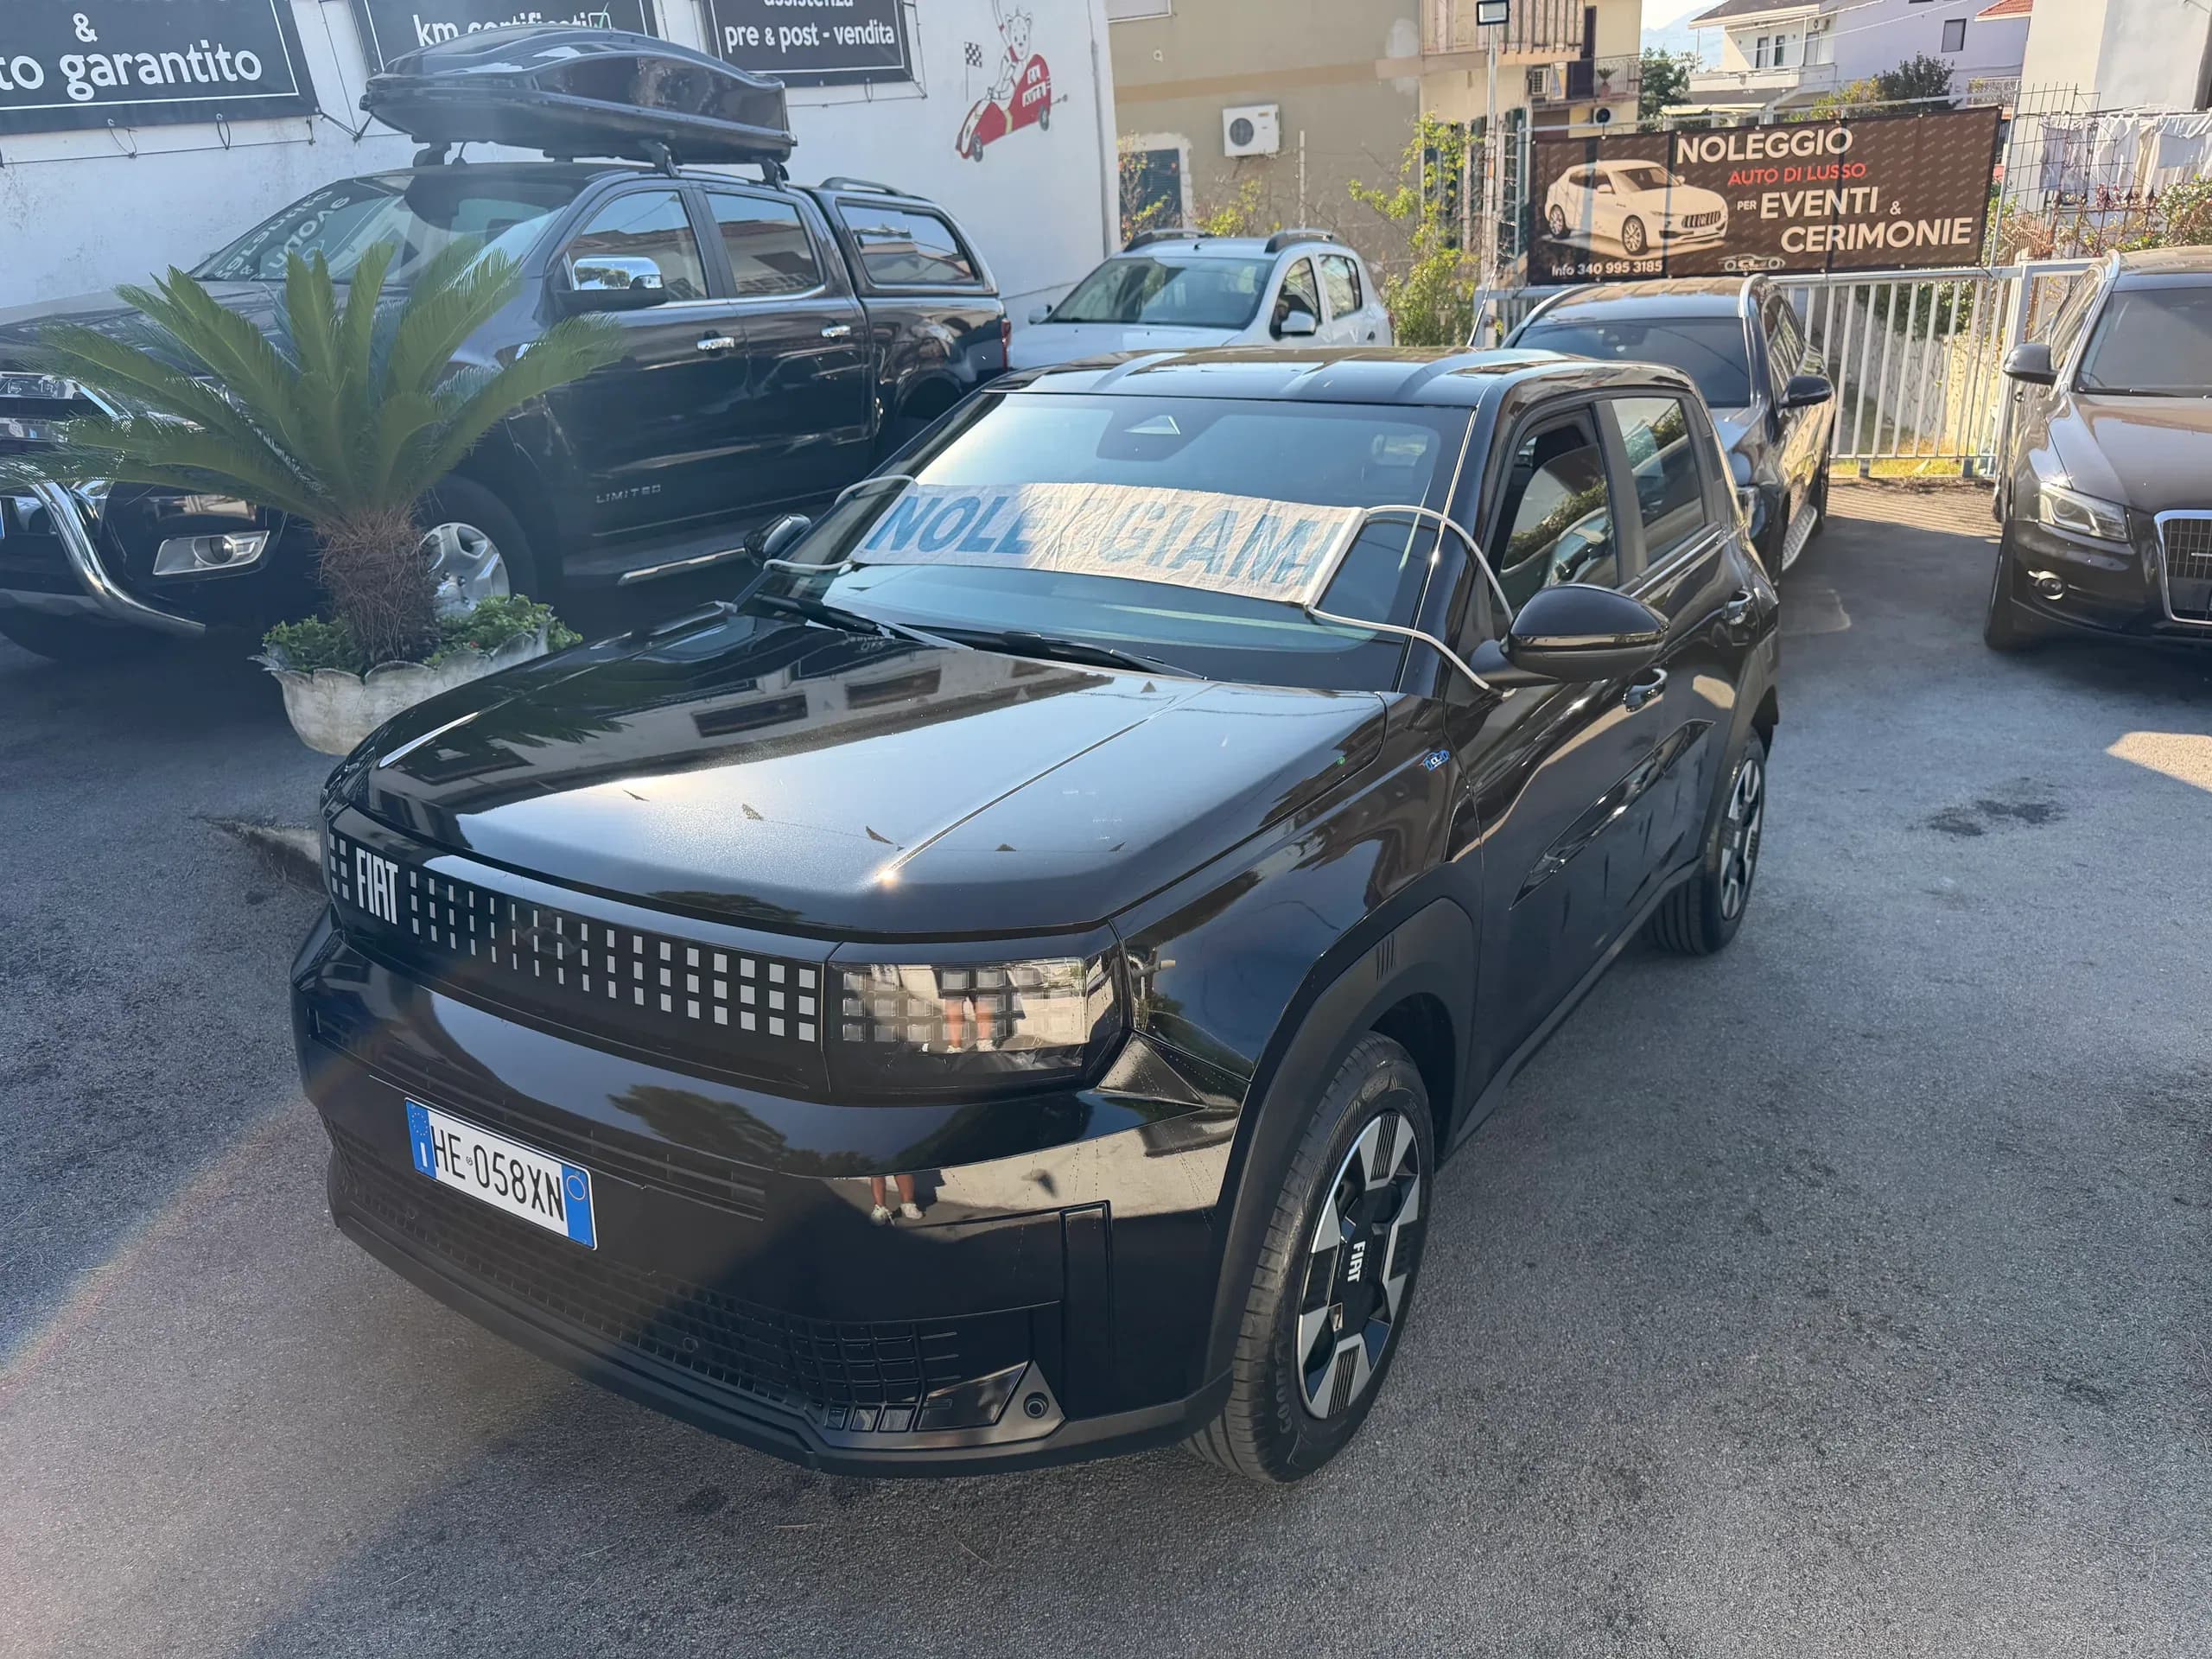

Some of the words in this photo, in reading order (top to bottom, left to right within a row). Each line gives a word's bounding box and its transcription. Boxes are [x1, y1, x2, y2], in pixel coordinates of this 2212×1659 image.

[73, 13, 99, 42] &
[413, 14, 459, 47] km
[724, 26, 760, 54] pre
[765, 27, 776, 46] &
[779, 22, 820, 54] post
[833, 19, 895, 45] vendita
[60, 39, 263, 101] garantito
[1676, 127, 1853, 164] NOLEGGIO
[1728, 168, 1779, 186] AUTO
[1783, 166, 1802, 182] DI
[1807, 162, 1866, 181] LUSSO
[1737, 200, 1757, 211] PER
[1760, 186, 1879, 219] EVENTI
[1889, 200, 1902, 216] &
[1781, 217, 1974, 254] CERIMONIE
[1551, 263, 1575, 277] Info
[1577, 262, 1604, 275] 340
[1605, 261, 1630, 274] 995
[1632, 259, 1663, 273] 3185
[596, 484, 662, 504] LIMITED
[356, 847, 399, 925] FIAT
[430, 1125, 467, 1180] HE
[473, 1144, 565, 1222] 058XN
[1347, 1241, 1366, 1282] FIAT
